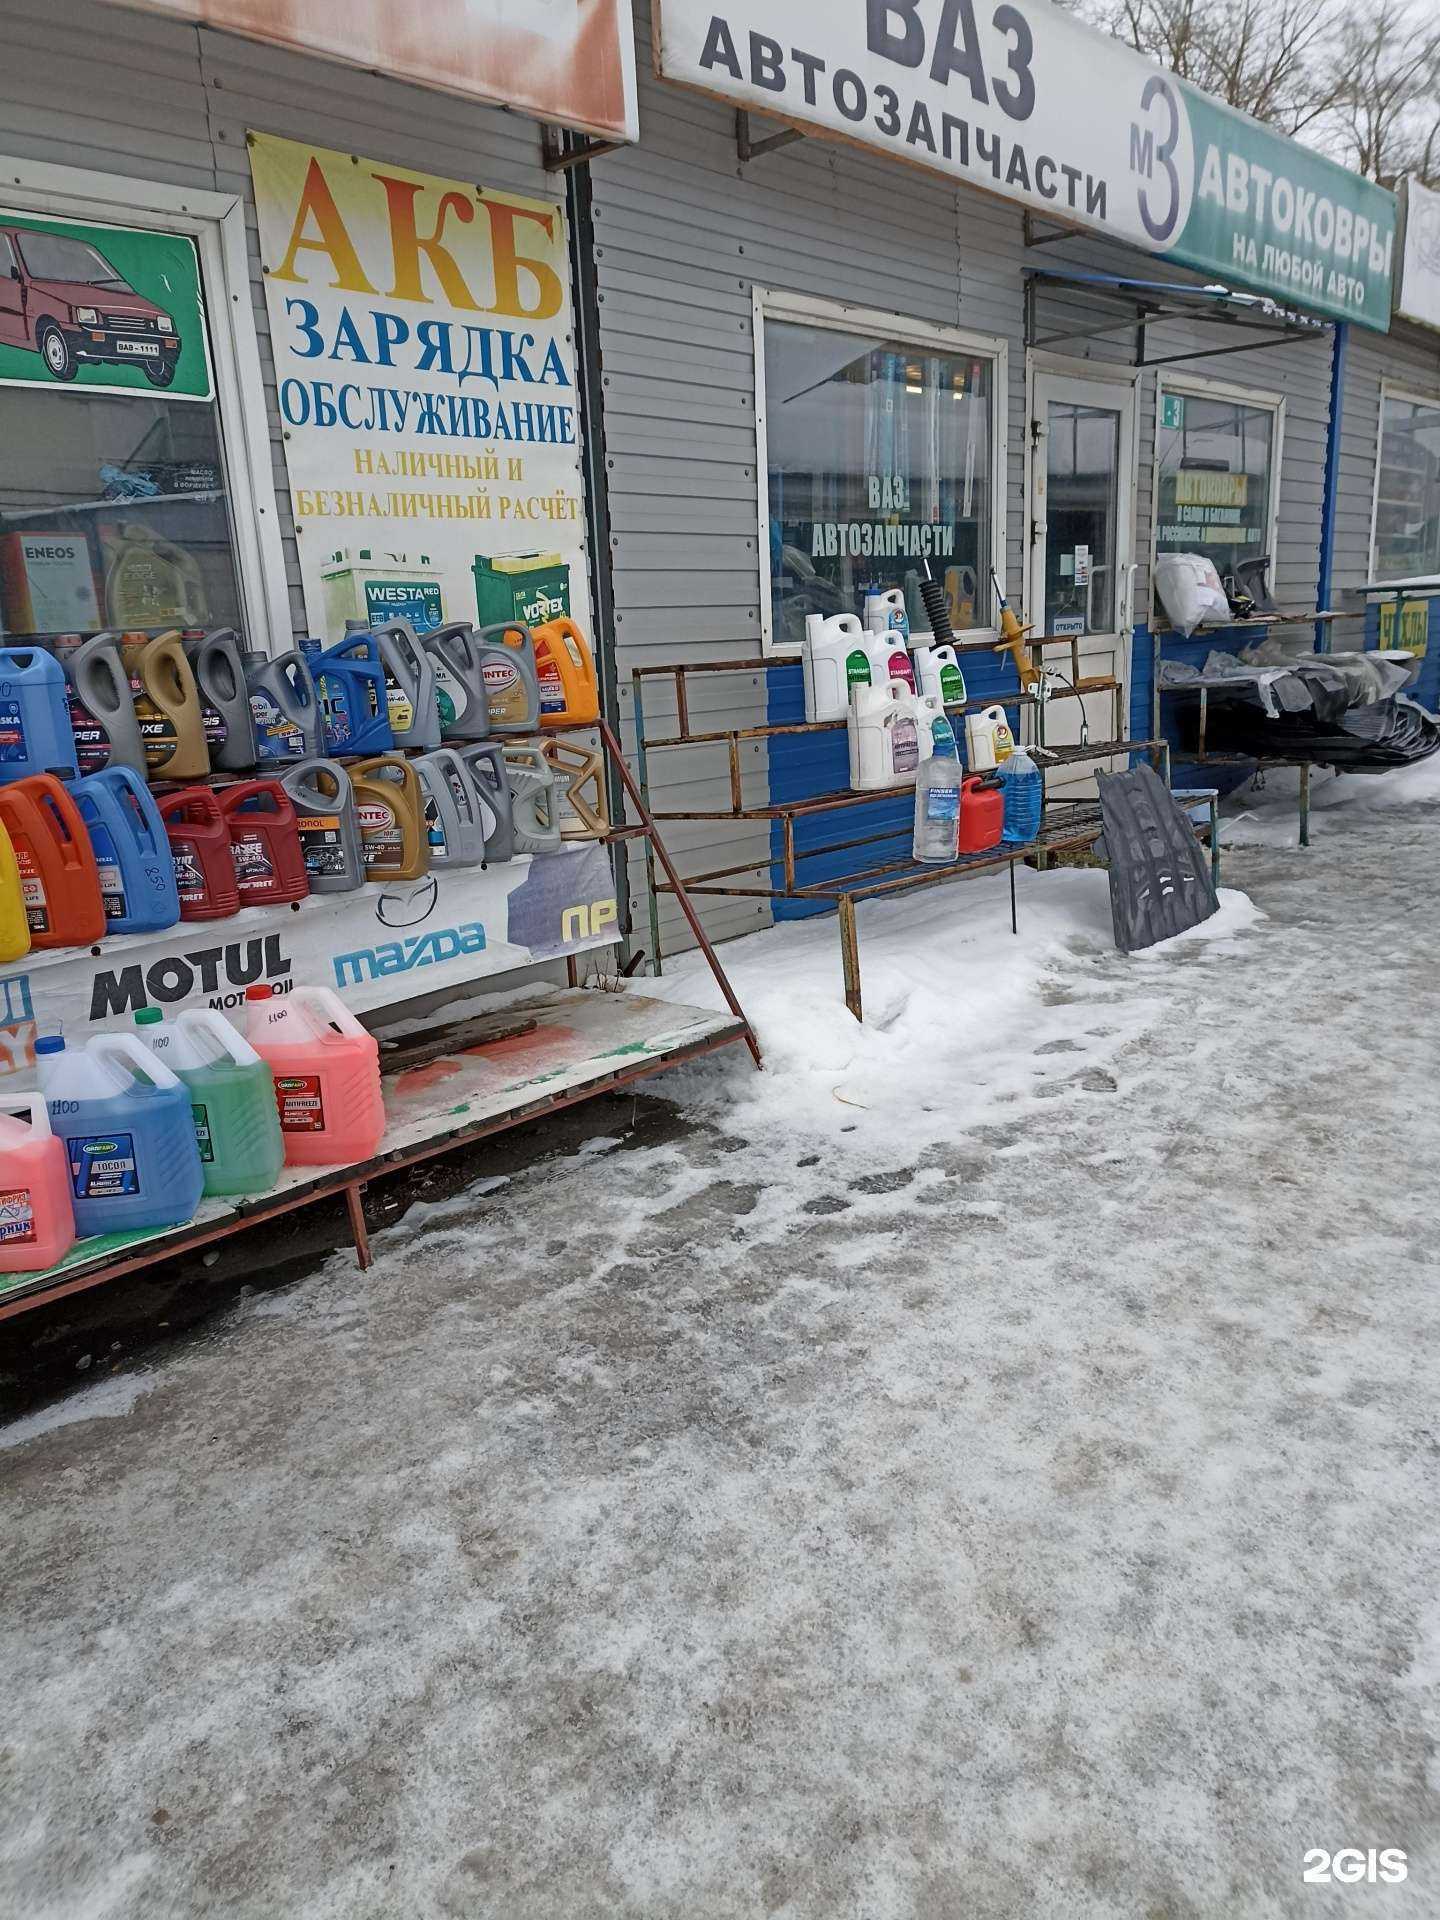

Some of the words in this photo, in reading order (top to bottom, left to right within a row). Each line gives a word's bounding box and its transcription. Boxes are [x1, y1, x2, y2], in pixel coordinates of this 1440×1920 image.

[866, 0, 1036, 121] ВАЗ
[698, 15, 1107, 220] АВТОЗАПЧАСТИ
[1198, 143, 1394, 278] АВТОКОВРЫ
[268, 155, 564, 320] АКБ
[1232, 232, 1257, 267] НА
[1261, 244, 1323, 289] ЛЮБОЙ
[1327, 273, 1364, 305] АВТО
[286, 297, 572, 392] ЗАРЯДКА
[281, 377, 576, 444] ОБСЛУЖИВАНИЕ
[353, 448, 498, 481] НАЛИЧНЫЙ
[507, 458, 523, 482] И
[295, 486, 492, 520] БЕЗНАЛИЧНЫЙ
[500, 491, 579, 520] РАСЧЁТ
[26, 546, 75, 559] ENEOS
[812, 523, 953, 557] АВТОЗАПЧАСТИ
[367, 587, 425, 601] WESTA
[522, 596, 563, 620] VORTEX
[1055, 622, 1083, 632] ОТКРЫТО
[1382, 611, 1428, 650] ЧХЛЫ
[482, 669, 514, 679] INTEC
[74, 730, 100, 741] PER
[359, 811, 389, 820] NTEC
[89, 934, 293, 1021] MOTUL
[208, 989, 247, 1011] MOT
[97, 1161, 126, 1171] ТОСОЛ
